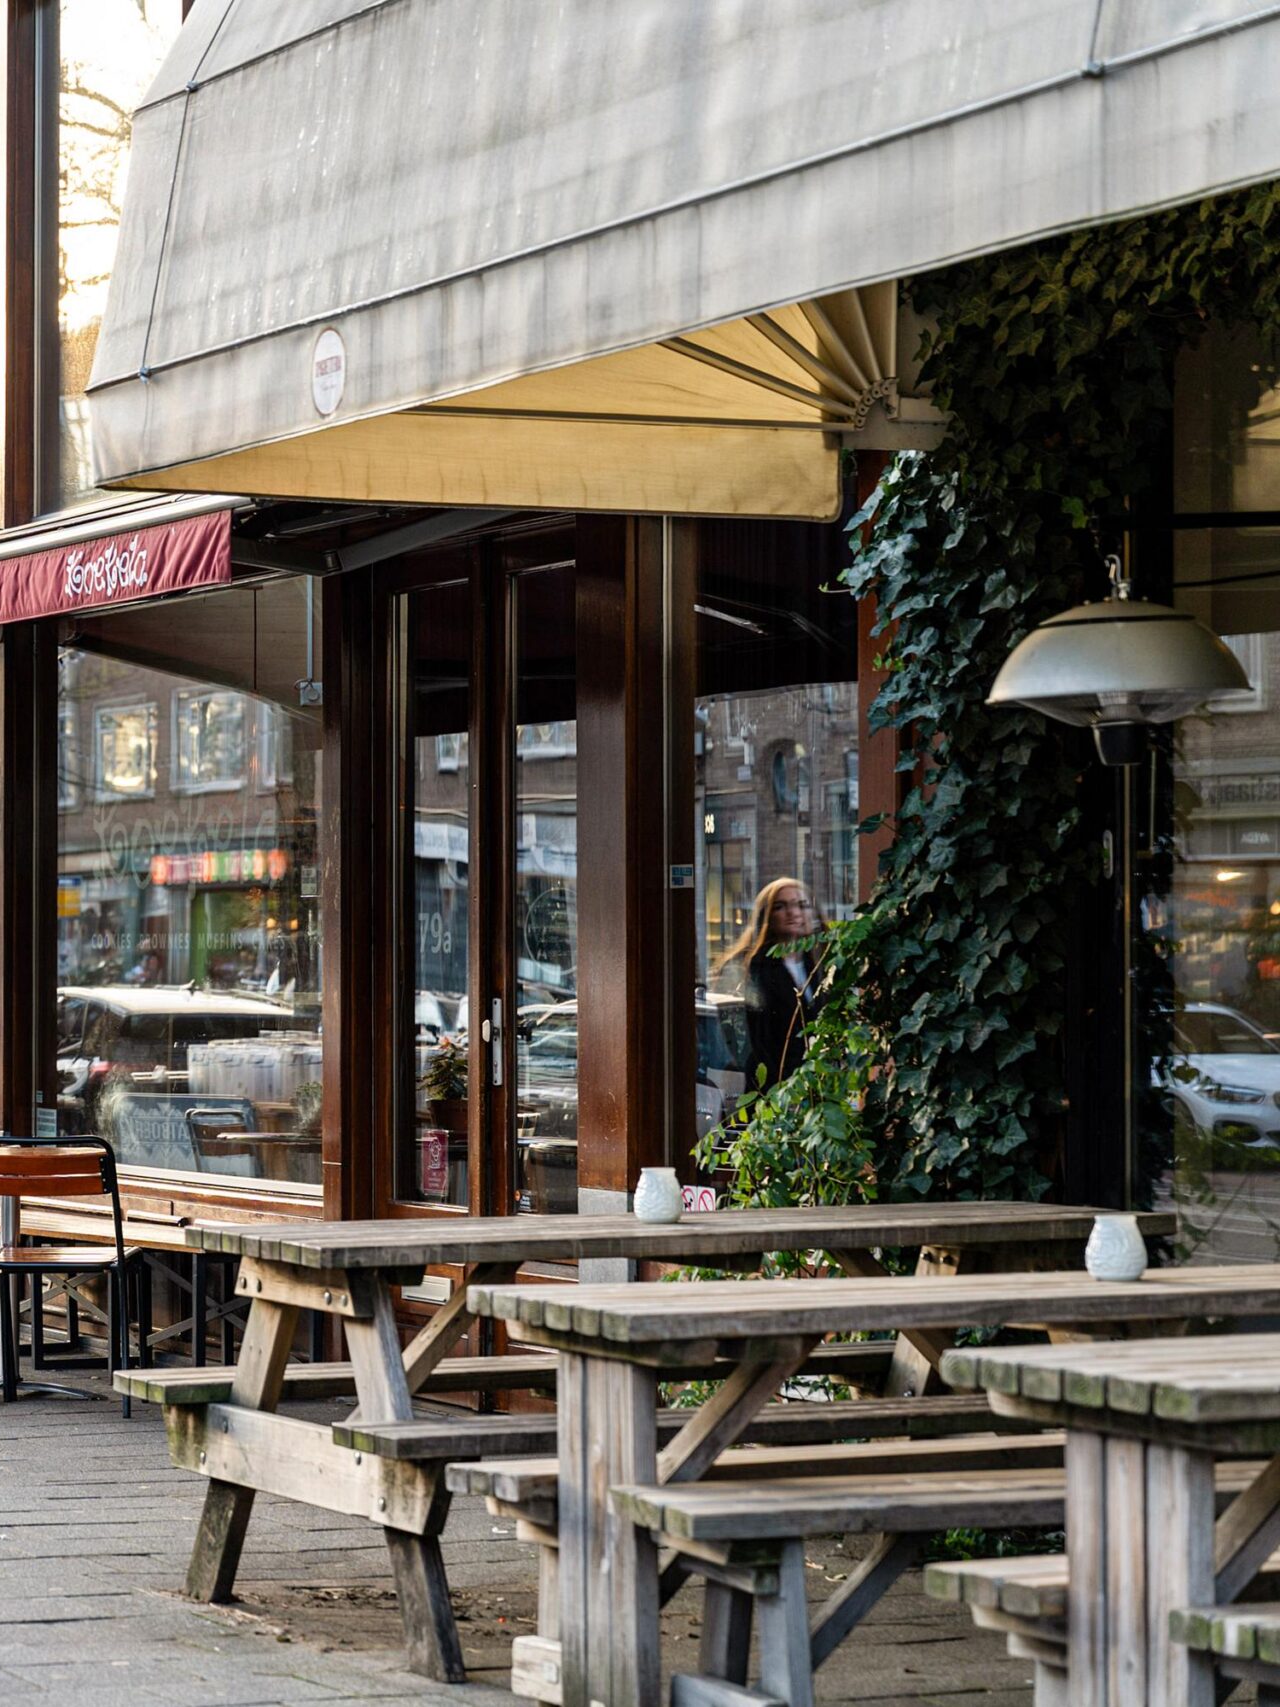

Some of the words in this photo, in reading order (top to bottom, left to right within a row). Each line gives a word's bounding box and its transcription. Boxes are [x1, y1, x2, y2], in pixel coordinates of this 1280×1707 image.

[64, 533, 148, 598] Koekela
[91, 933, 131, 950] COOKIES
[140, 933, 190, 949] BROWNIES
[198, 933, 243, 949] MUFFINS
[418, 912, 452, 954] 79a
